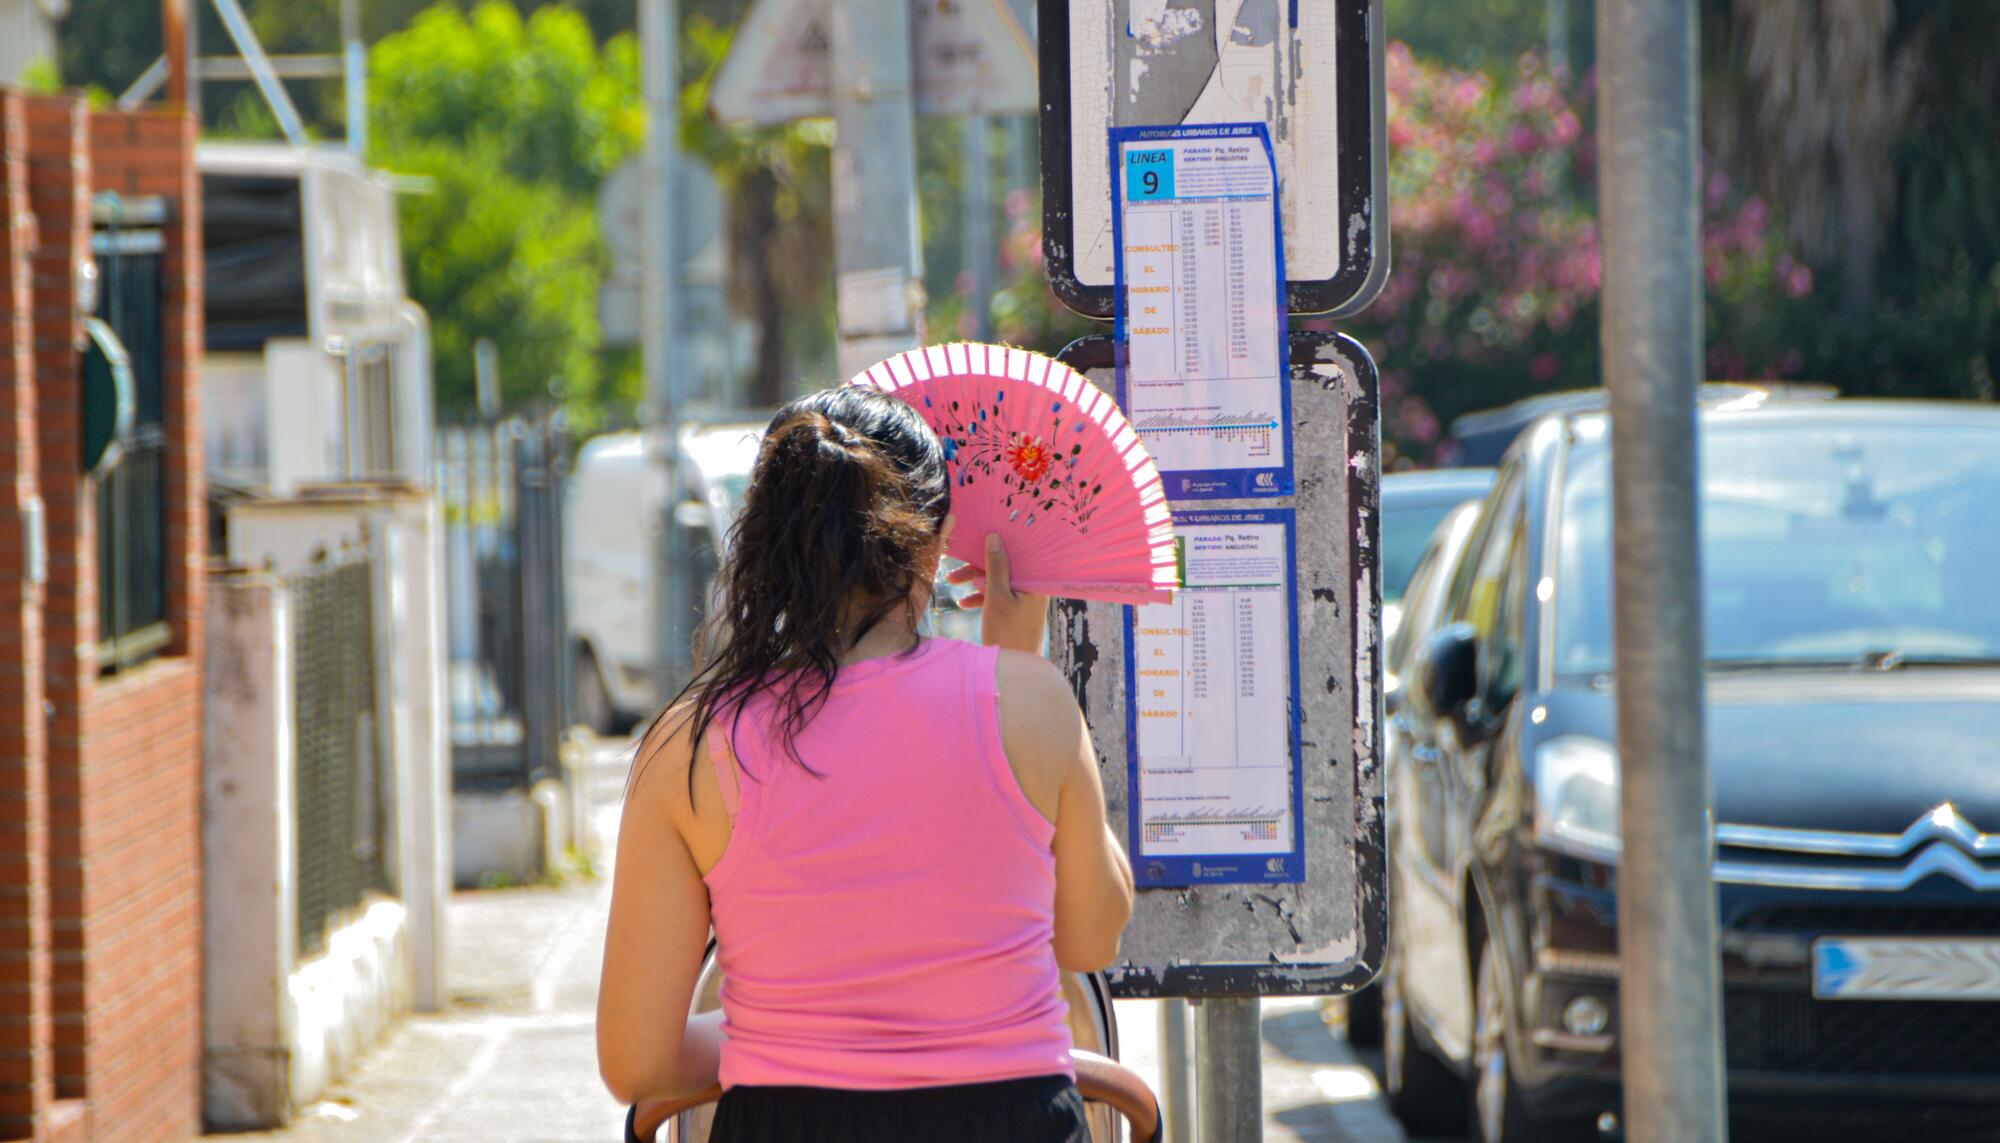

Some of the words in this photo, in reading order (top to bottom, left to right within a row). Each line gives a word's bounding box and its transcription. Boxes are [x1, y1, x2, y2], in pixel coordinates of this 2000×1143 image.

[1183, 127, 1218, 137] URBANOS
[1231, 126, 1253, 135] JEREZ
[1228, 146, 1250, 154] Retiro
[1143, 170, 1159, 195] 9
[1144, 265, 1155, 273] EL
[1131, 286, 1169, 294] HORARIO
[1144, 306, 1157, 314] DE
[1195, 514, 1230, 522] URBANOS
[1139, 669, 1179, 677] HORARIO
